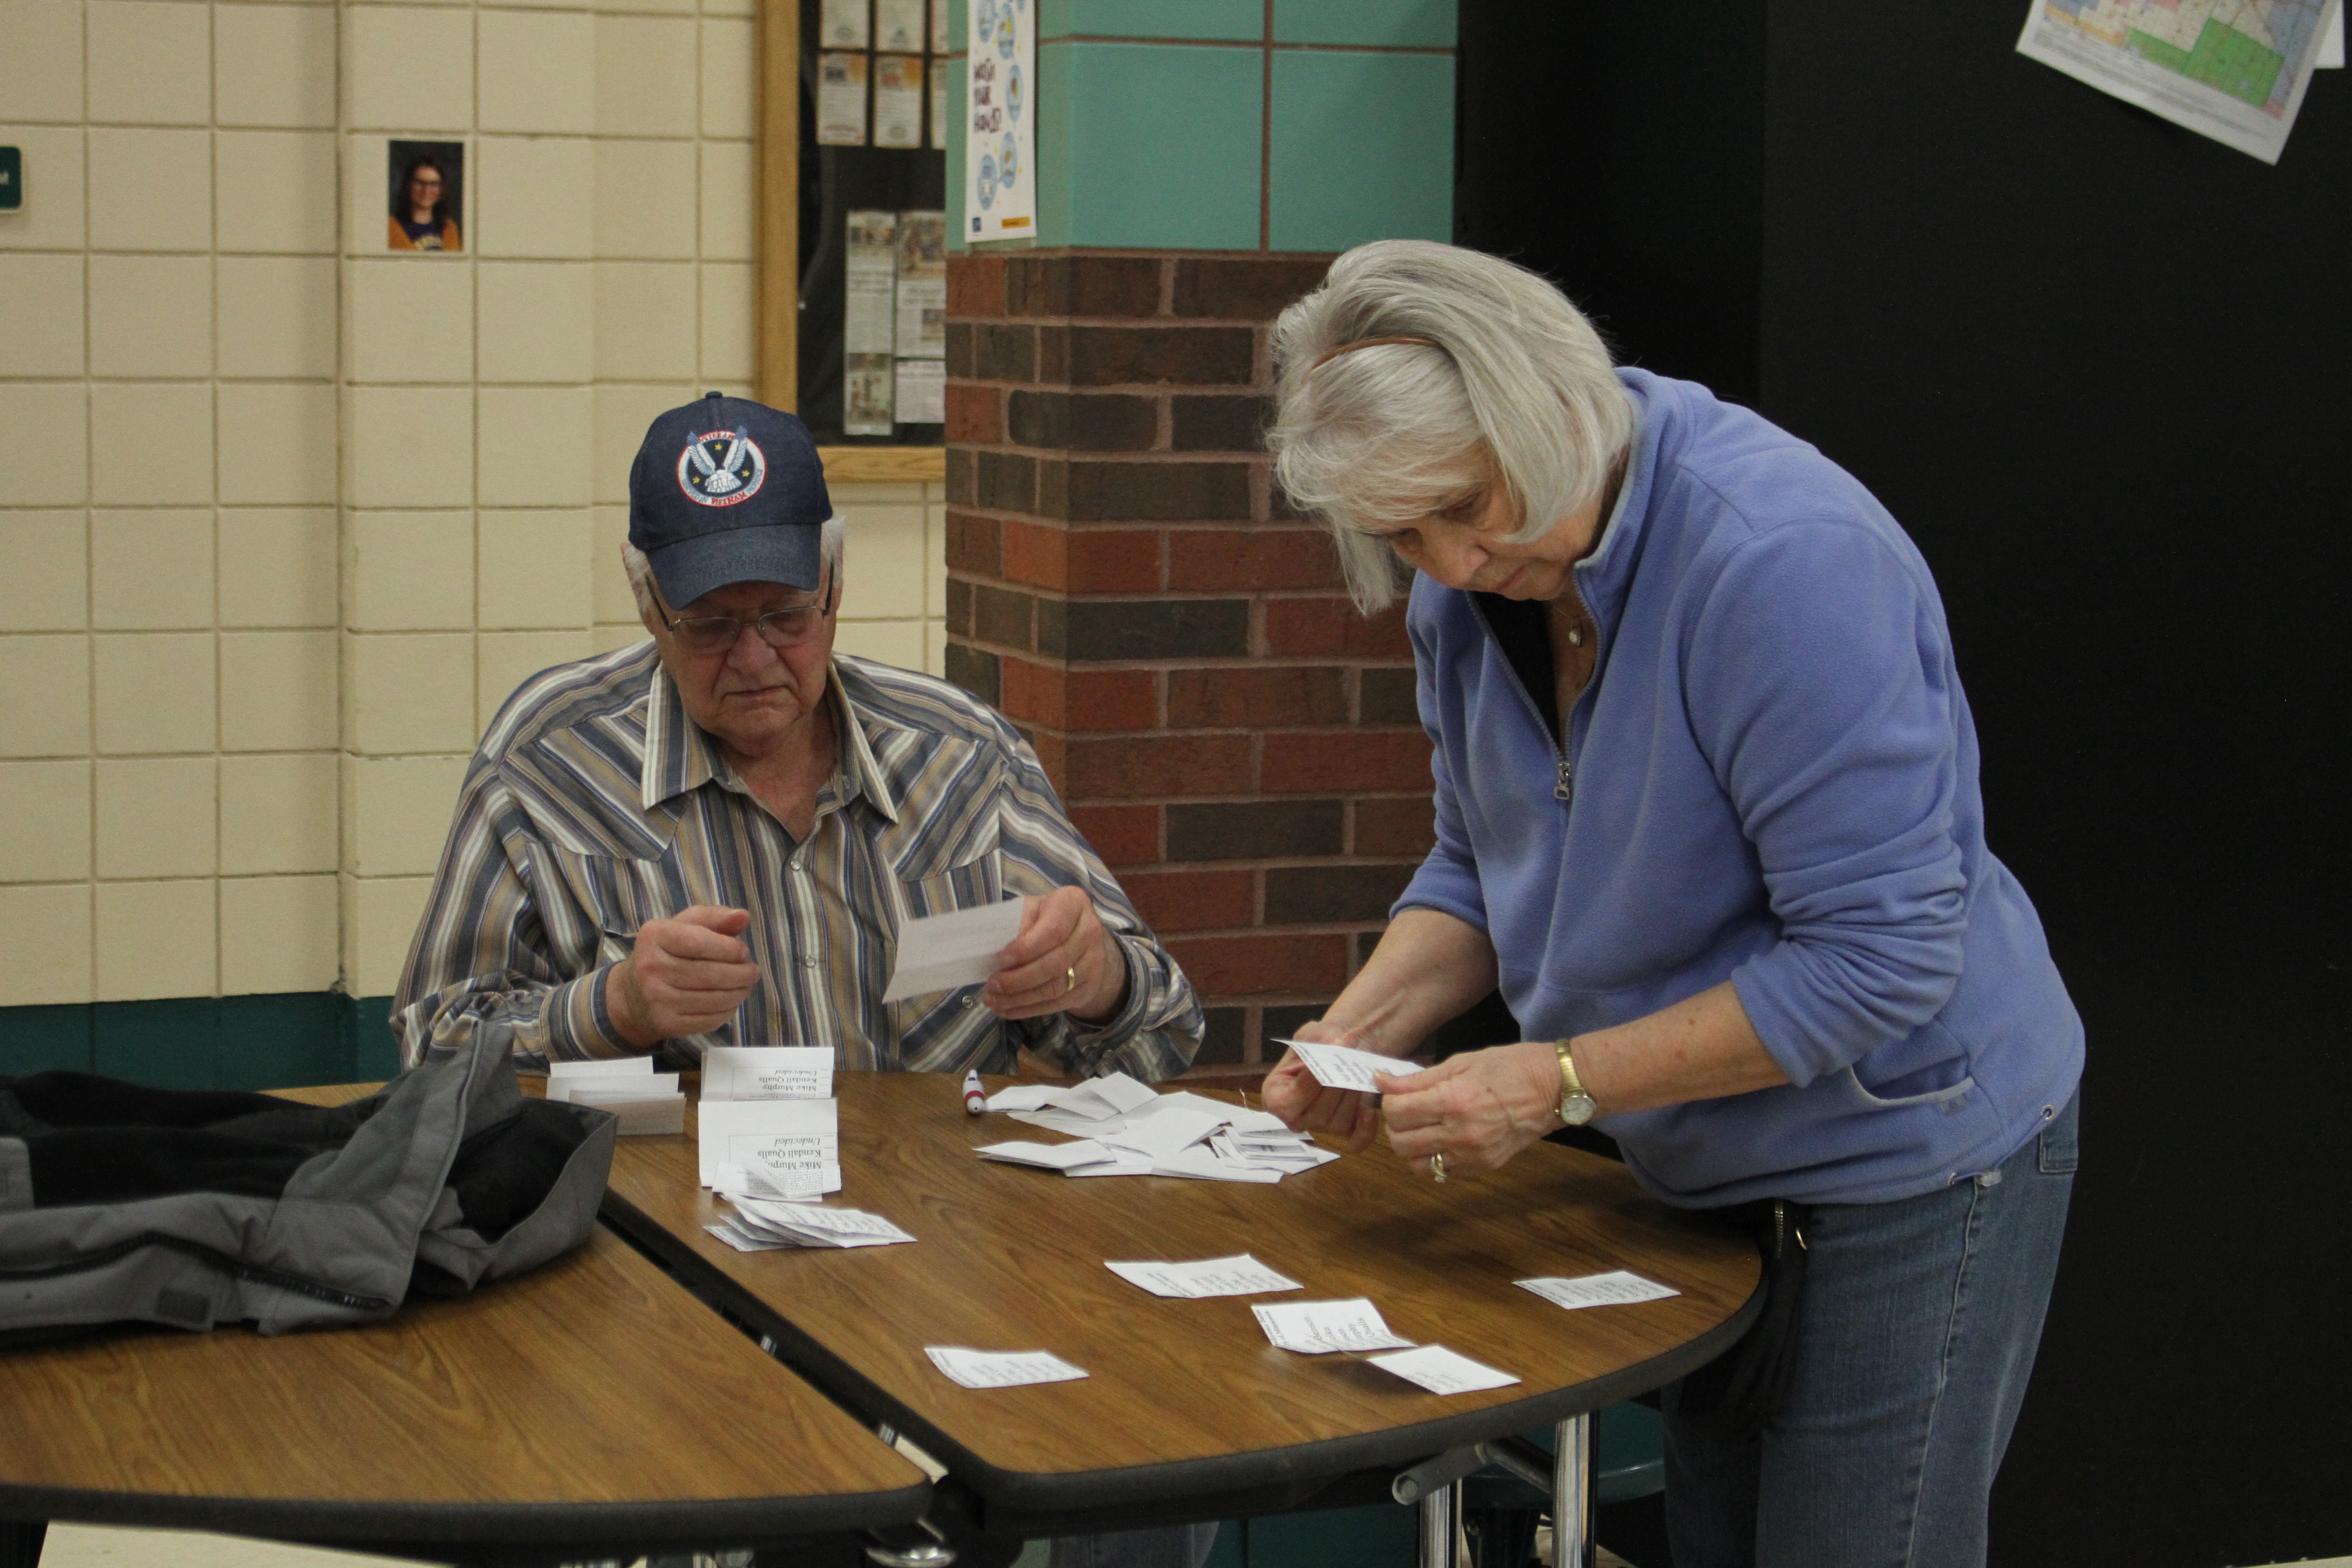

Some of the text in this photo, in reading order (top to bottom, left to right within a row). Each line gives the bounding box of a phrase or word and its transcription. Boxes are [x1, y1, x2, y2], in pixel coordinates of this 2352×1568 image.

[711, 491, 746, 505] VIETNAM
[775, 1138, 821, 1147] Undecided
[757, 1149, 821, 1159] Kendall Qualls
[799, 1161, 822, 1170] Mike
